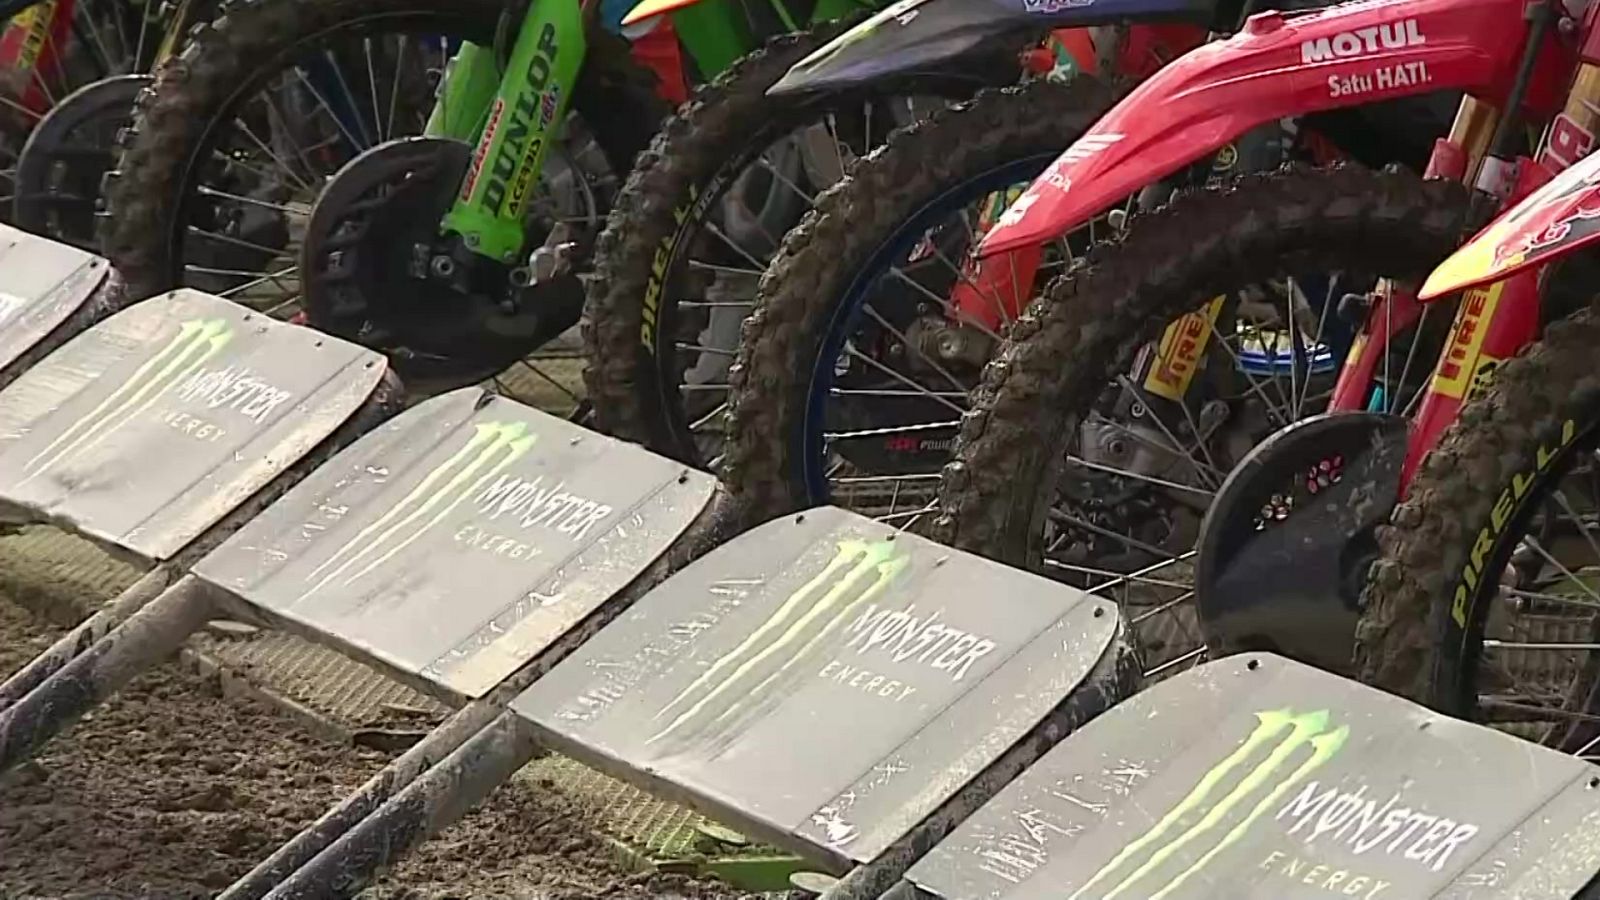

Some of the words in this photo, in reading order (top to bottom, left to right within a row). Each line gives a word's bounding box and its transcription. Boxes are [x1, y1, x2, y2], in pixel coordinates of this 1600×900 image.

[1301, 19, 1425, 64] MOTUL
[1328, 73, 1373, 98] Satu
[481, 22, 558, 218] DUNLOP
[453, 525, 544, 562] ENERGY
[1451, 418, 1575, 629] PIRELLI
[817, 660, 917, 703] ENERGY
[1257, 849, 1393, 900] ENERGY
